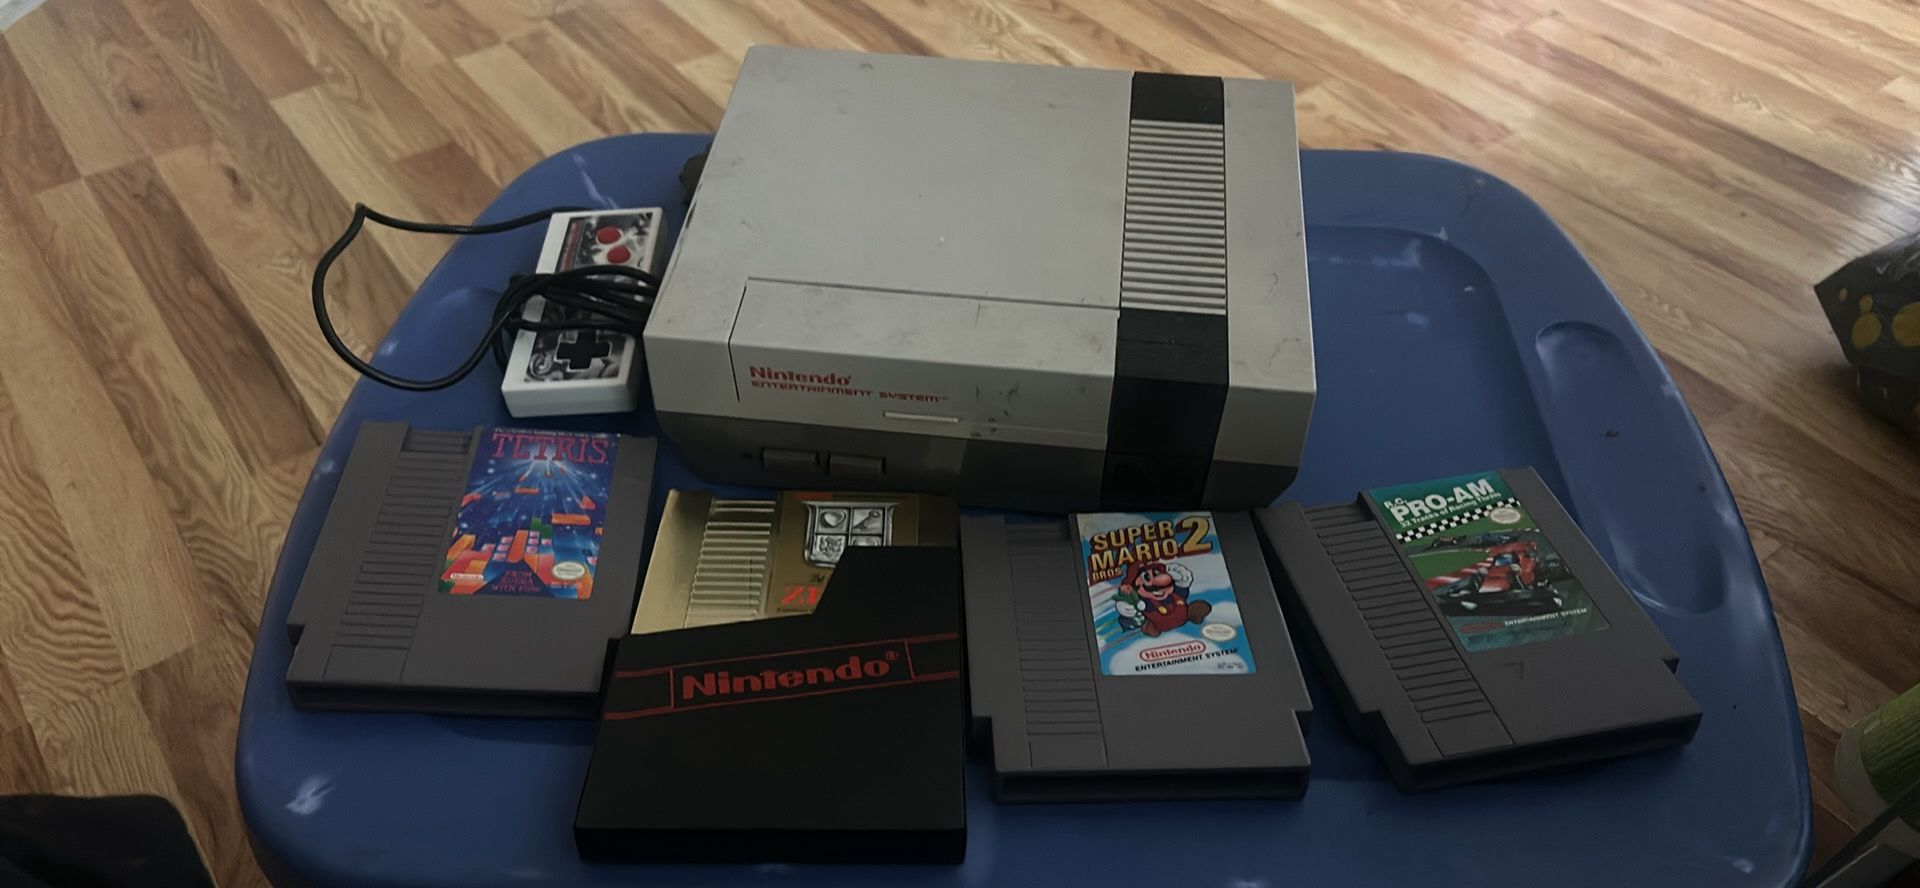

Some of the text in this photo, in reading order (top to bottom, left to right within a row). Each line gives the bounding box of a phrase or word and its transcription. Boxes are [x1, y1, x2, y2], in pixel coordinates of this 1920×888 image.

[491, 432, 609, 465] TETRIS
[1390, 478, 1496, 524] PRO-AM
[1091, 515, 1213, 556] SUPER 2
[1089, 538, 1178, 571] MARIO
[1135, 655, 1202, 671] ENTERTAINMENT
[1205, 647, 1239, 660] SYSTEM
[1144, 643, 1202, 660] Nintendo
